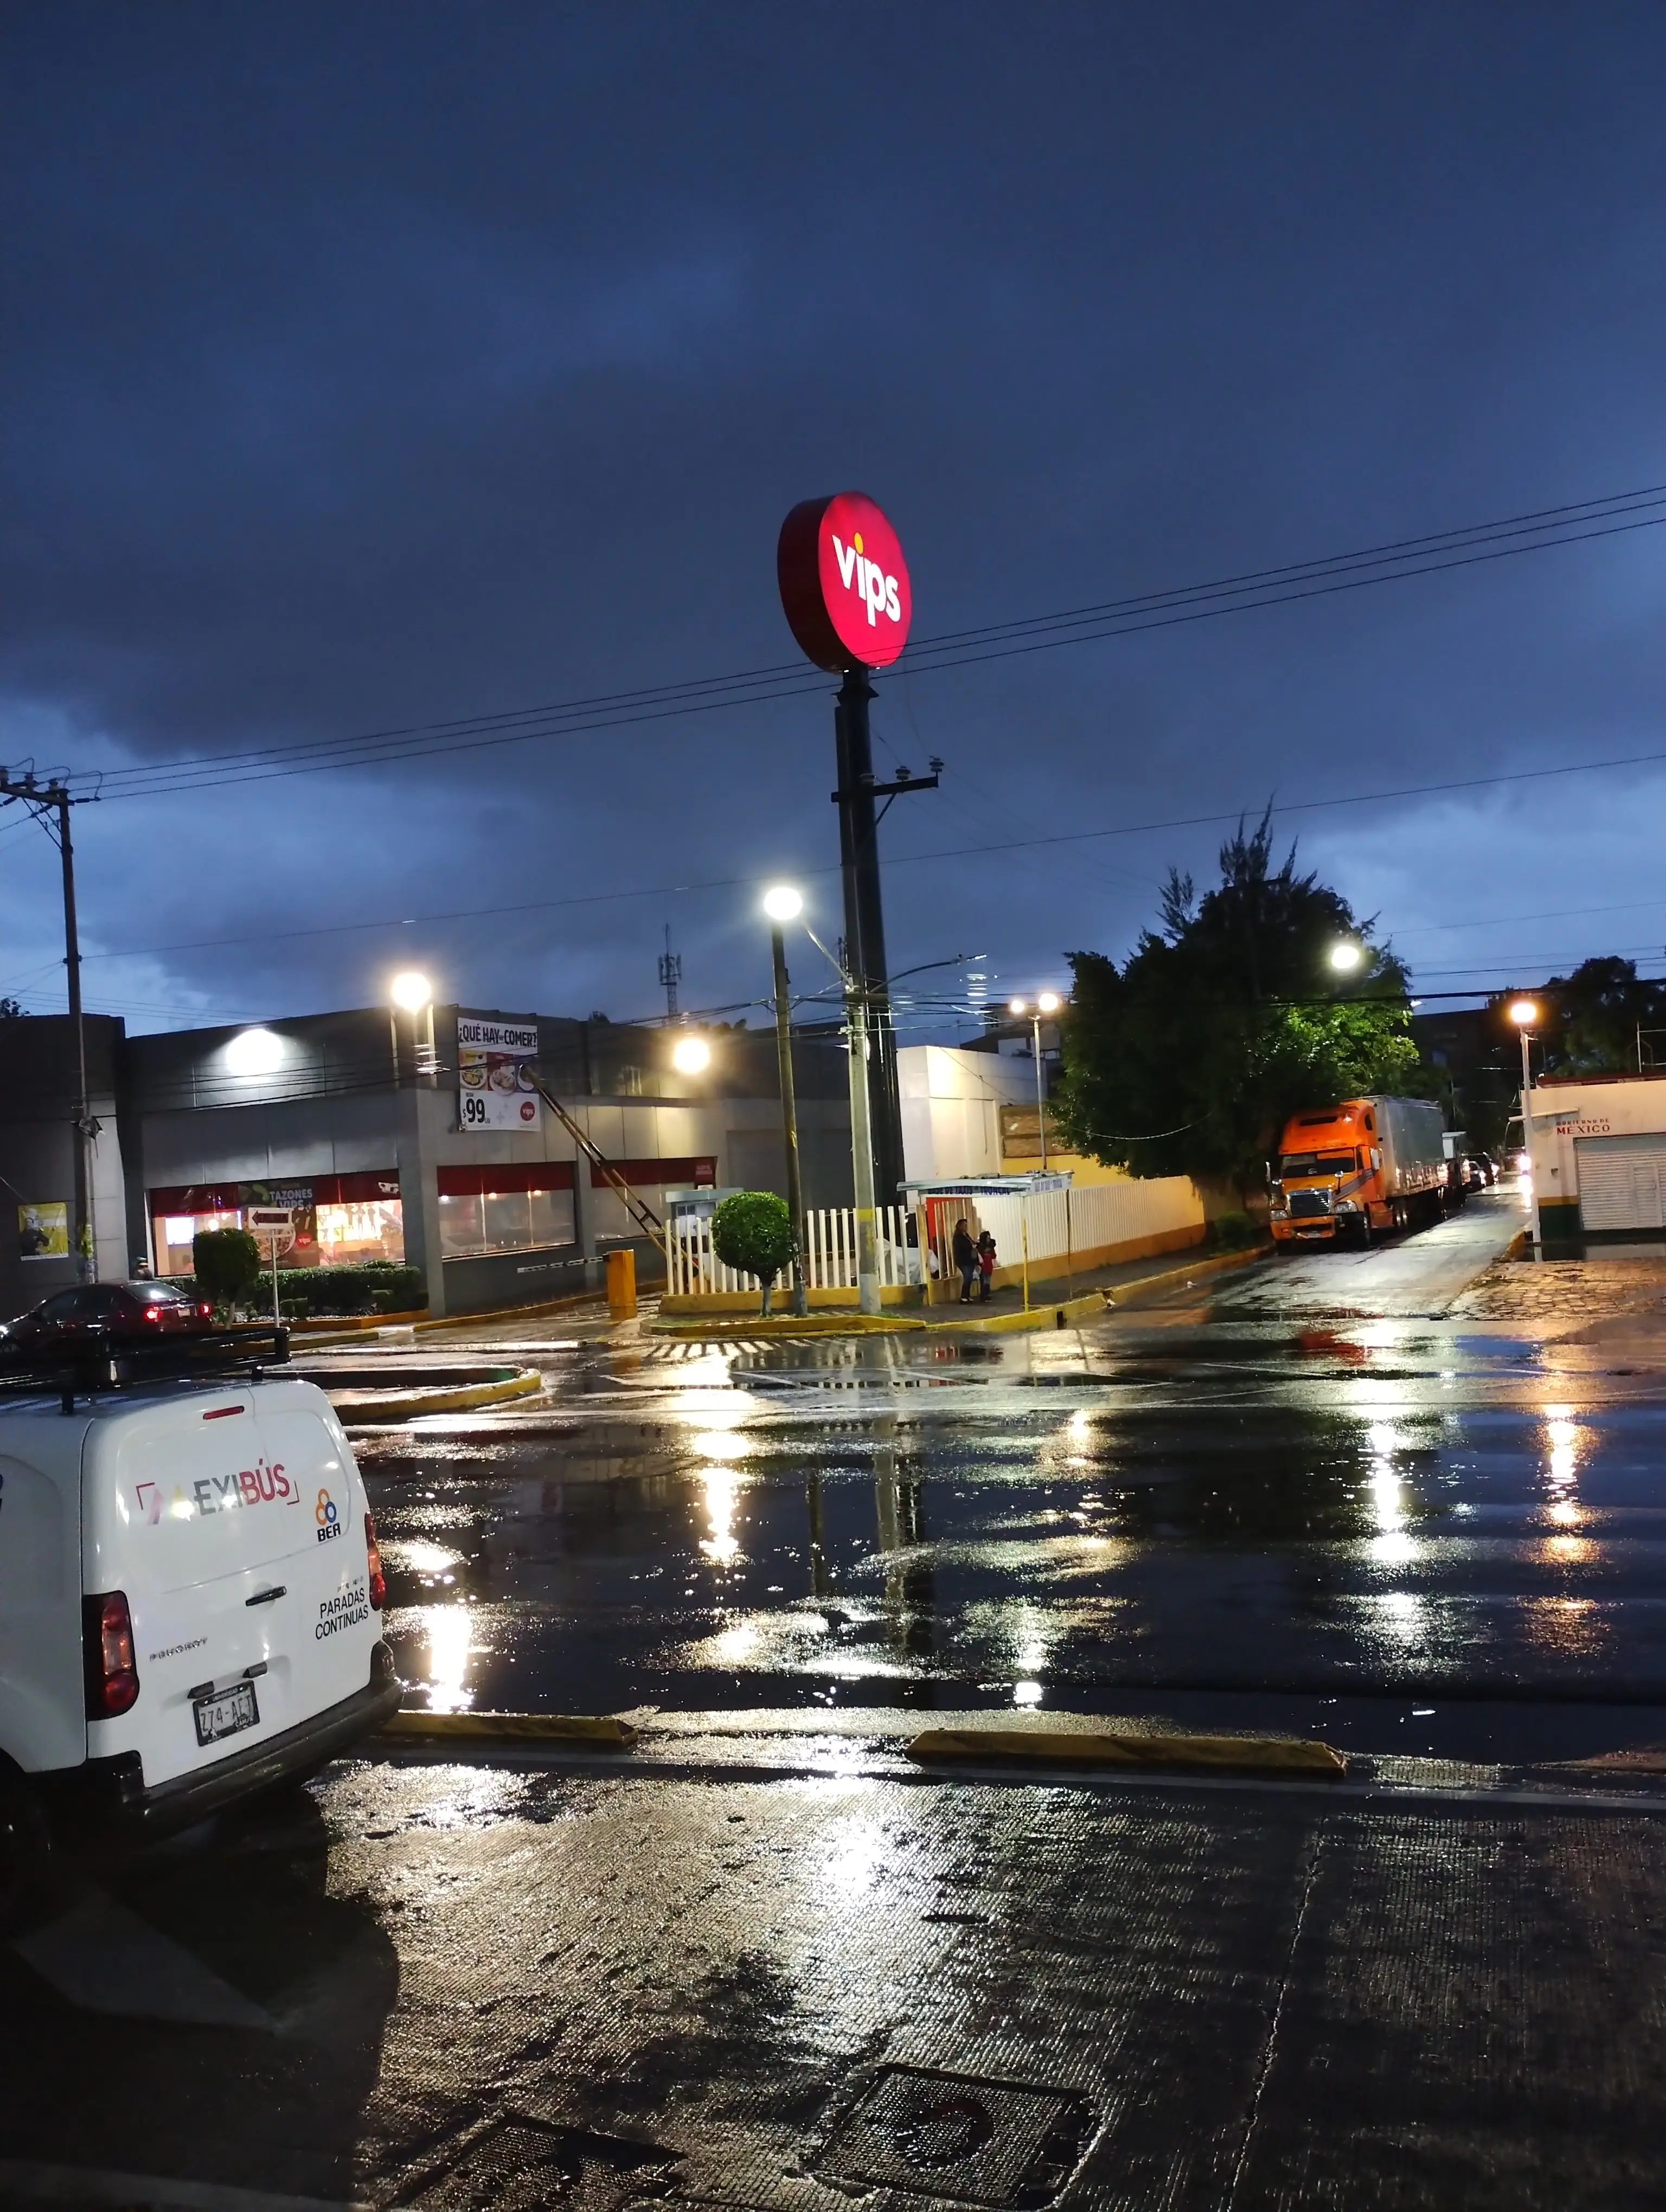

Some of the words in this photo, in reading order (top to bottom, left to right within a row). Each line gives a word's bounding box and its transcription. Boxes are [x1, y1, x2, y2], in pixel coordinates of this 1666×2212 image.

[483, 1027, 499, 1044] HAY
[504, 1030, 536, 1047] COMER?
[270, 1188, 312, 1201] TAZONES
[320, 1587, 364, 1619] PARADAS
[315, 1604, 369, 1640] CONTINUAS
